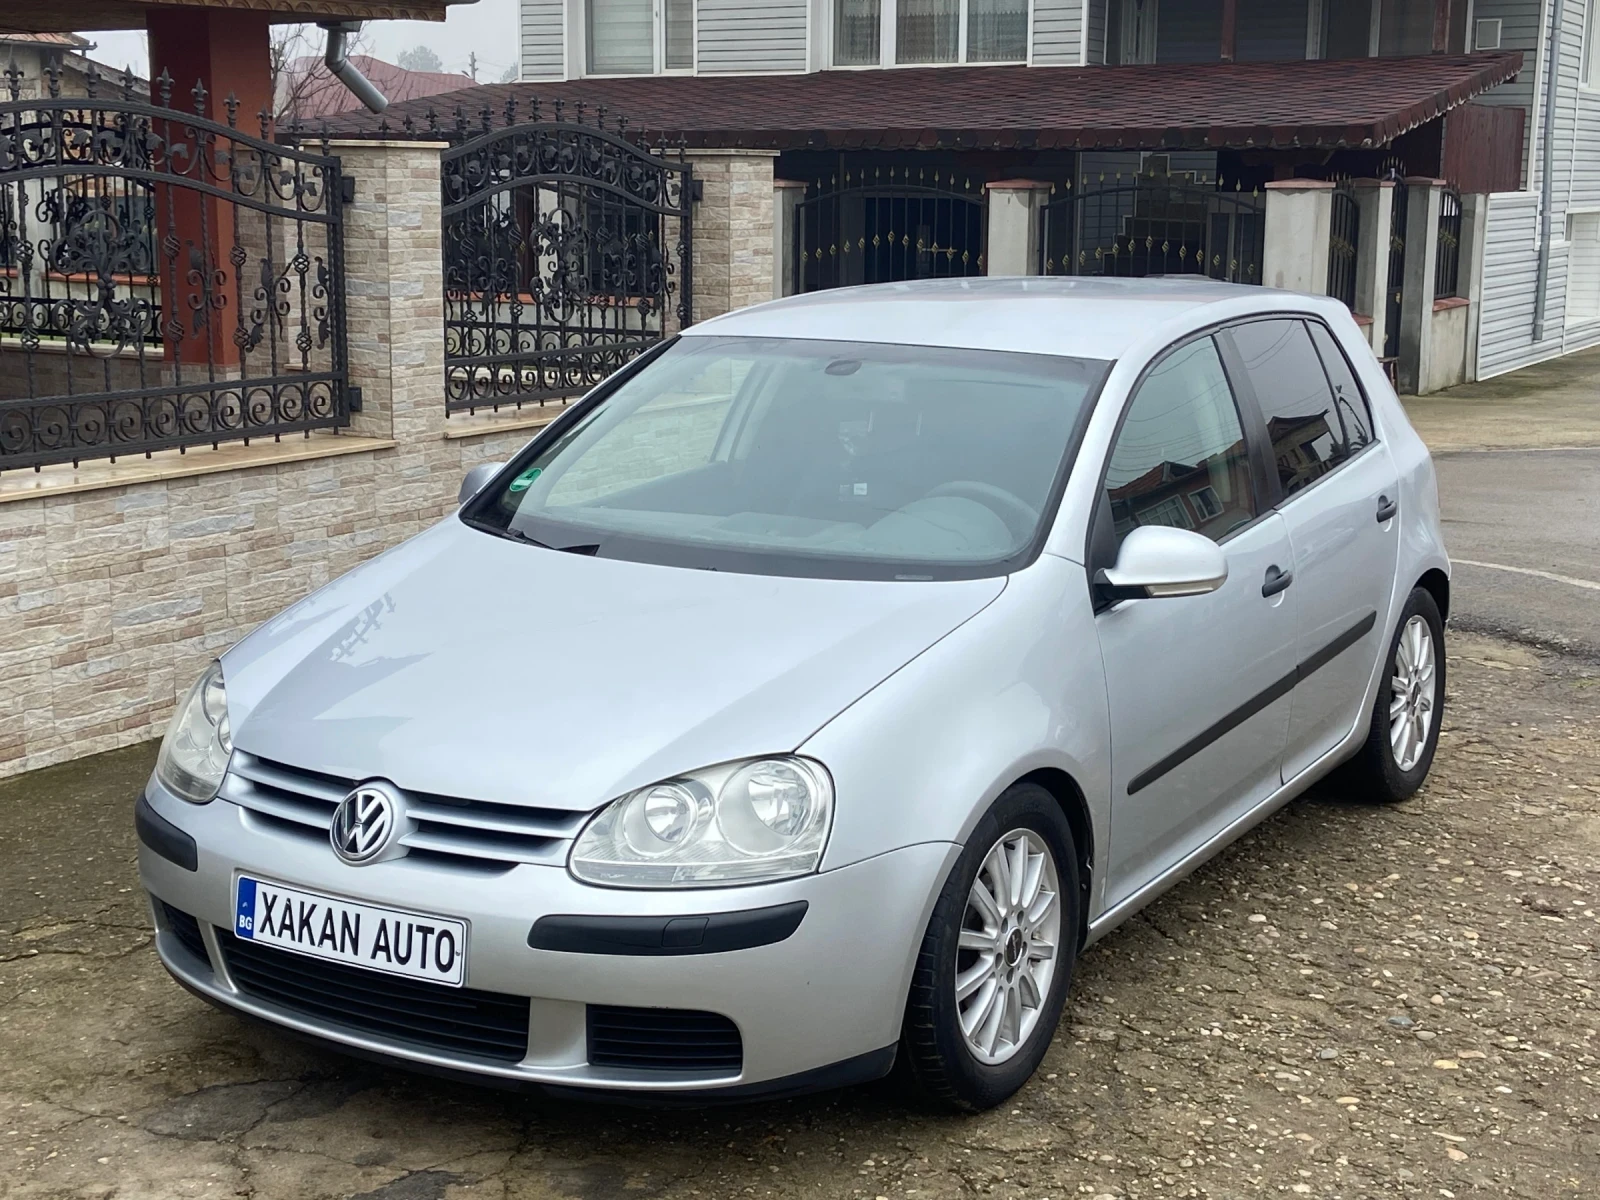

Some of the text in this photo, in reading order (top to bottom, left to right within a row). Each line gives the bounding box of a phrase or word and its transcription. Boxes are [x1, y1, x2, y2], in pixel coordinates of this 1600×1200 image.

[335, 788, 392, 859] VW
[239, 915, 252, 930] BG
[259, 891, 456, 973] XAKAN AUTO
